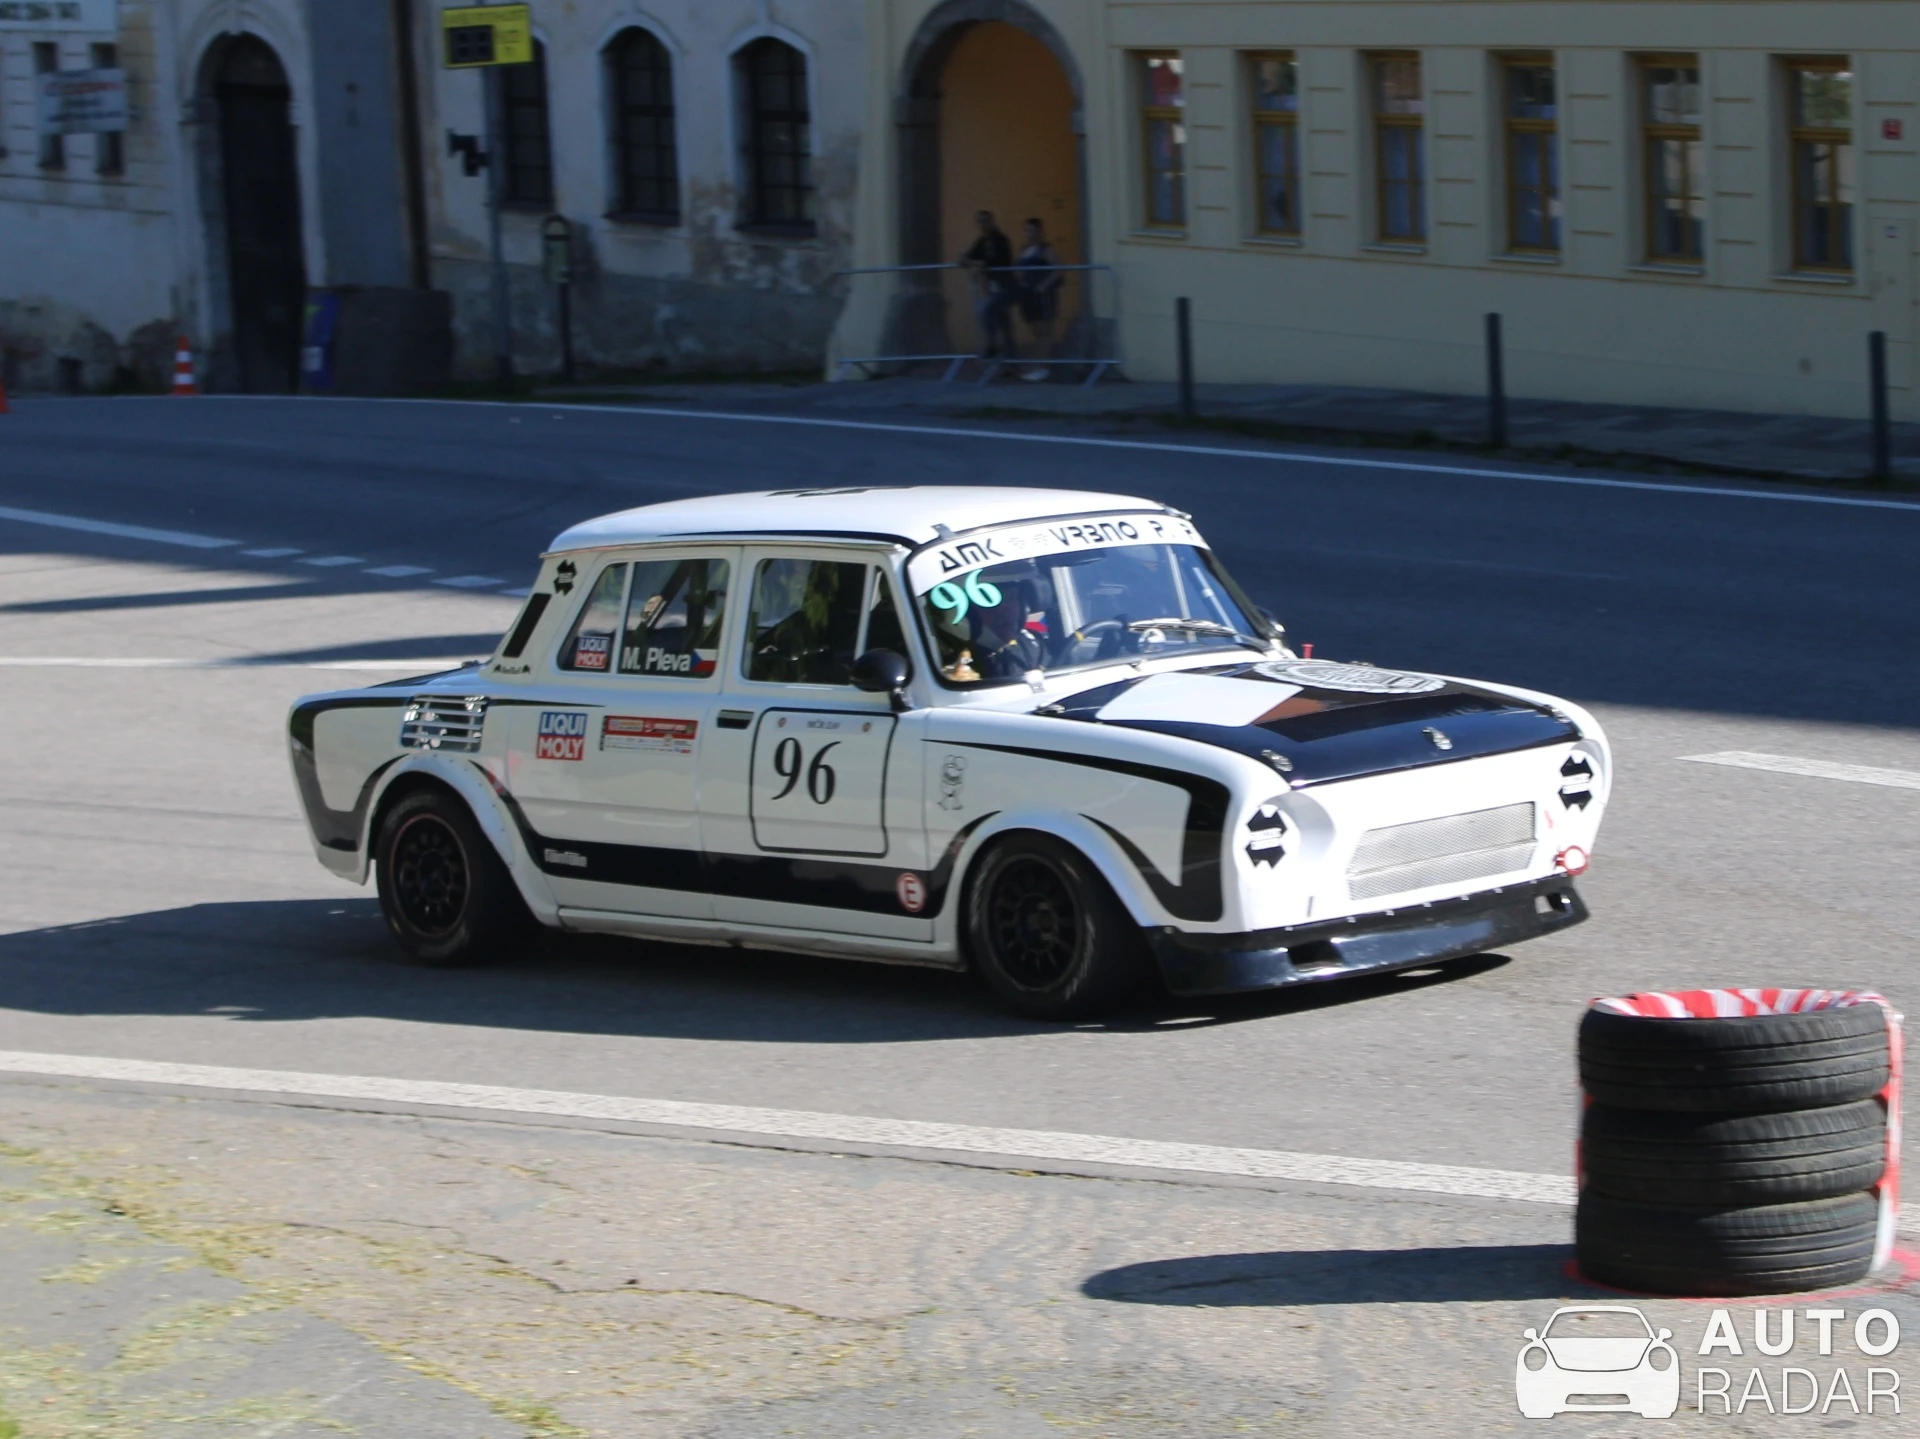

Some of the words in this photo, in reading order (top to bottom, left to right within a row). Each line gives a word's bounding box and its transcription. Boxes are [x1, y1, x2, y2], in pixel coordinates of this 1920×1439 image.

[937, 538, 1005, 575] AMK
[930, 568, 1003, 626] 96
[578, 637, 608, 651] LIQUI
[576, 652, 607, 667] MOLY
[621, 647, 641, 669] M.
[645, 647, 692, 671] Pleva
[540, 714, 586, 735] LIQUI
[538, 736, 584, 758] MOLY
[771, 737, 842, 804] 96
